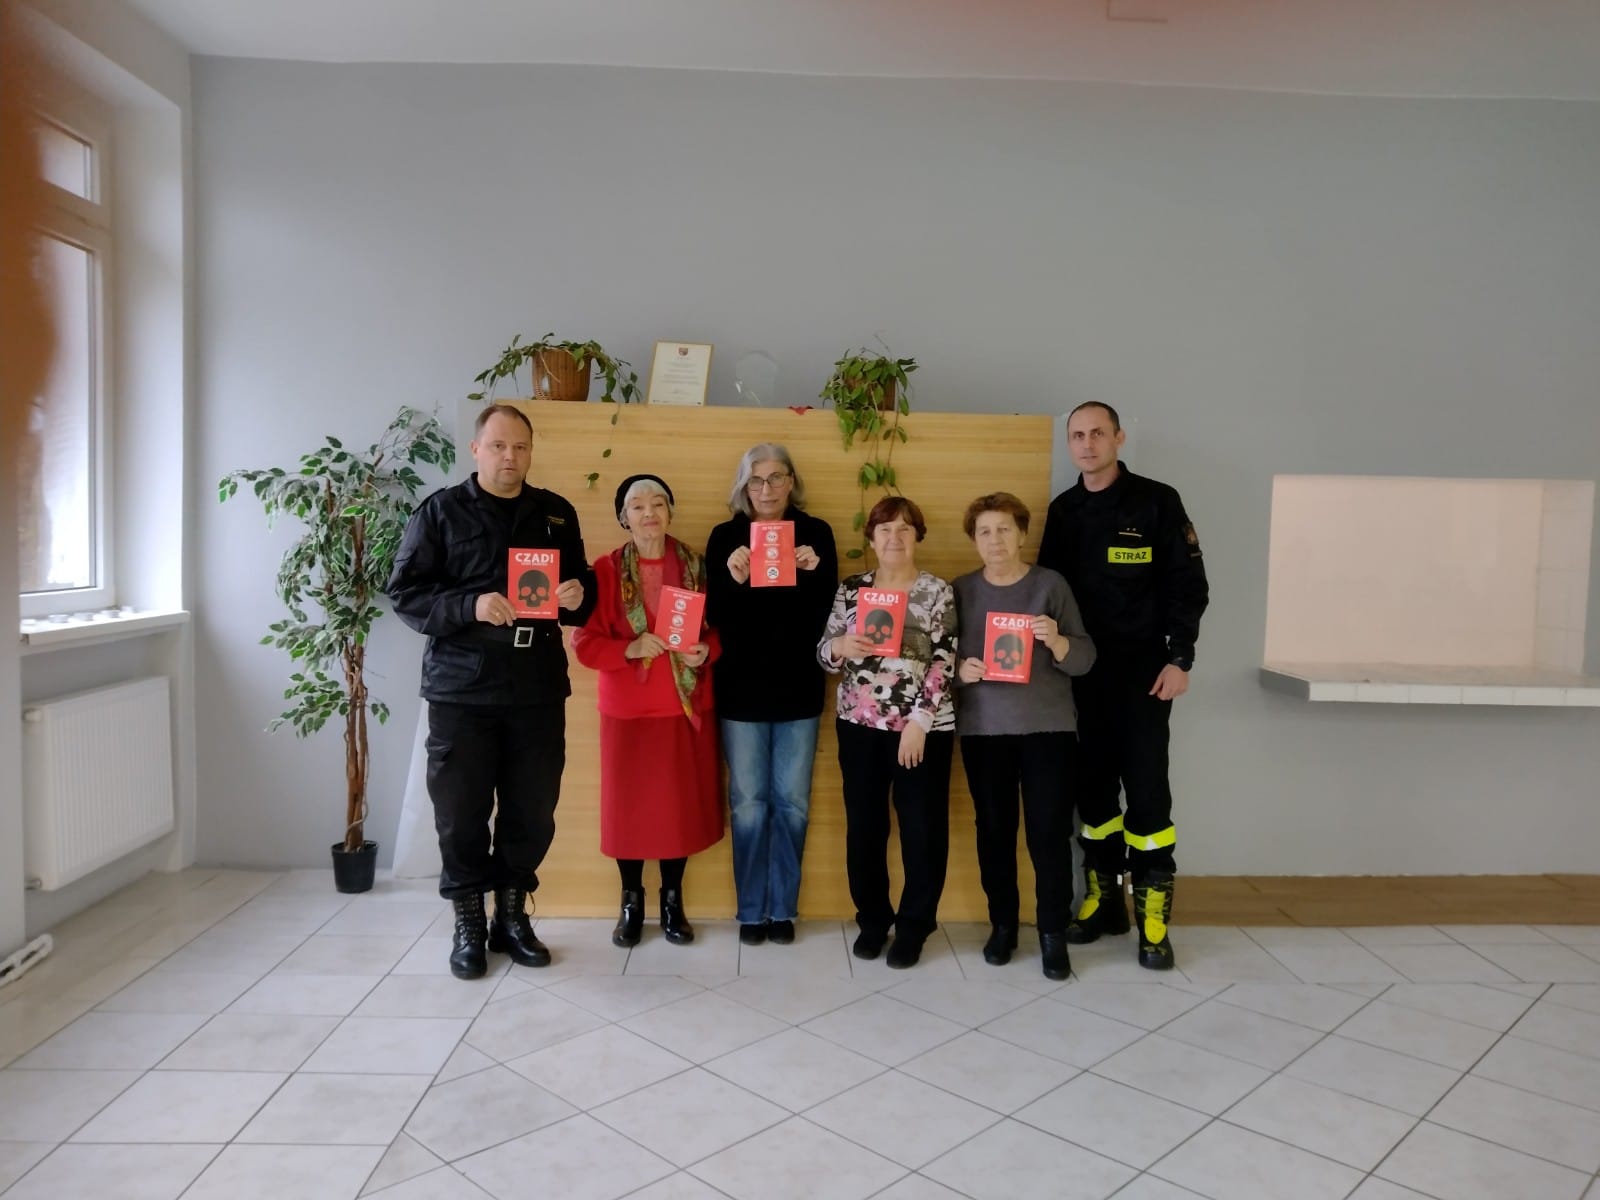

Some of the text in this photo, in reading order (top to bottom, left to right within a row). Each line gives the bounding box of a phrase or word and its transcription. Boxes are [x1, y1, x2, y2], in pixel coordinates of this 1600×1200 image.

[515, 552, 554, 564] CZAD!
[863, 592, 899, 604] CZAD!
[992, 616, 1029, 629] CZAD!
